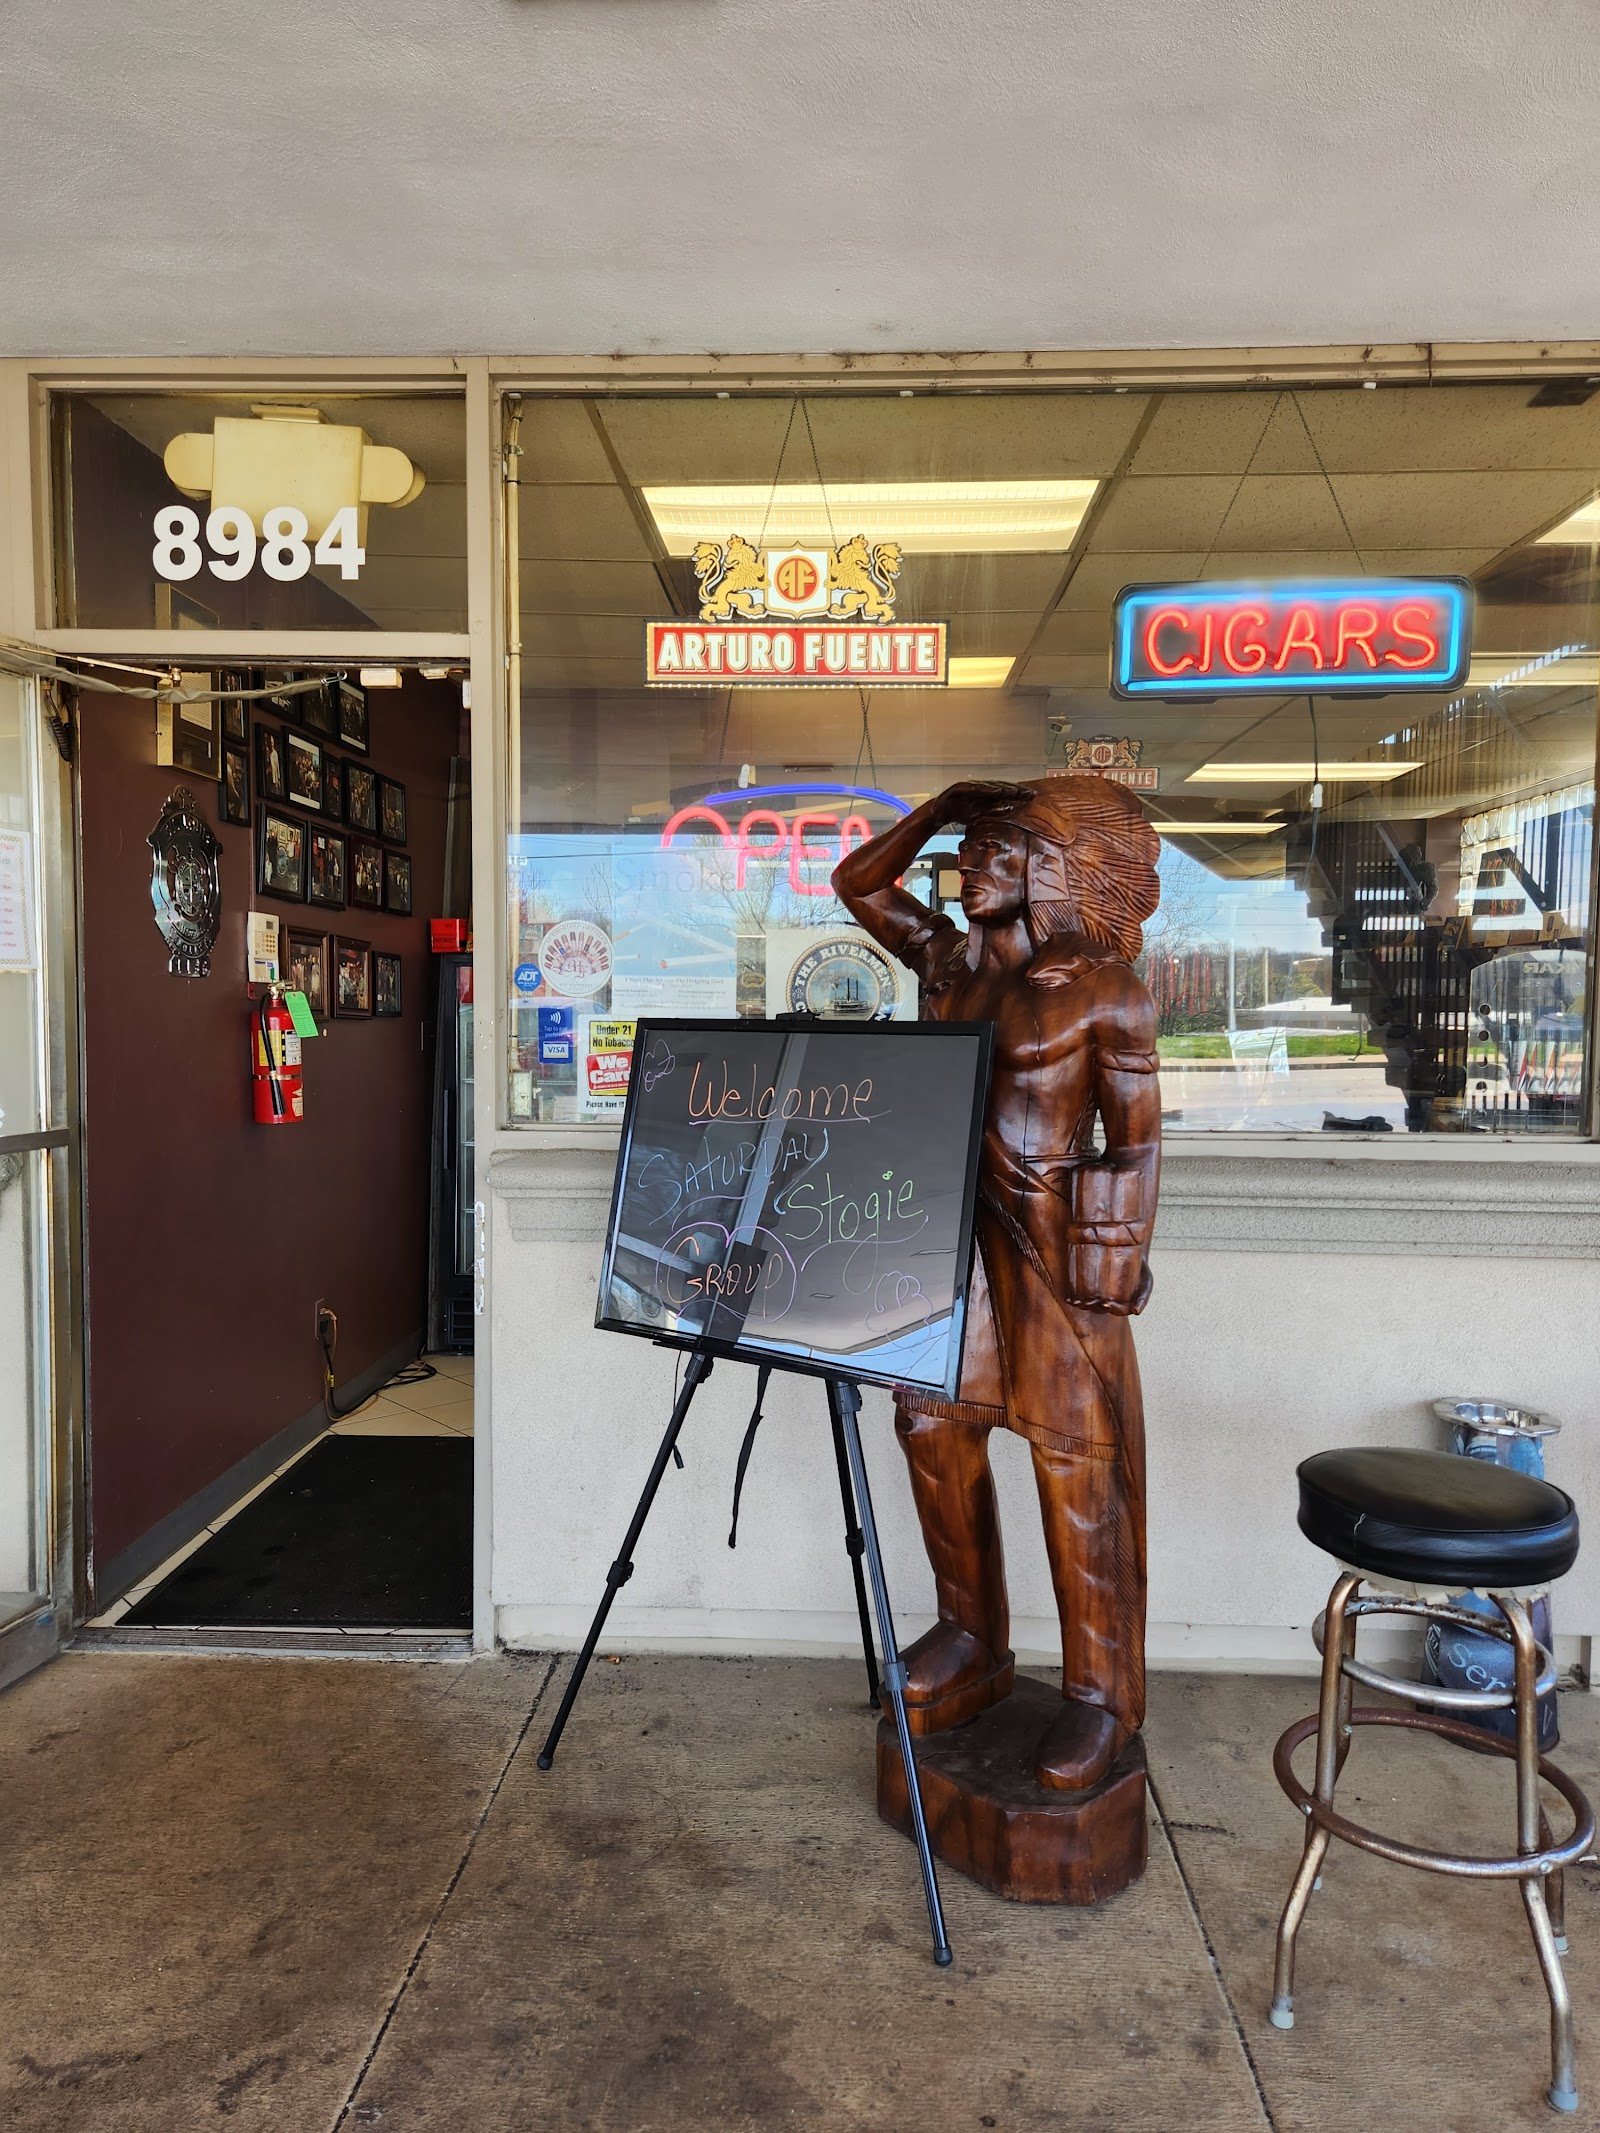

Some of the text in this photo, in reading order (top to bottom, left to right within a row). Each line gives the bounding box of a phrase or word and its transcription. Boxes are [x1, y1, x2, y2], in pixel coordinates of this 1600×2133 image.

[153, 505, 366, 581] 8984
[778, 558, 815, 598] AF
[657, 632, 937, 672] ARTURO FUENTE
[1147, 607, 1436, 675] CIGARS
[518, 971, 538, 981] ADT
[795, 944, 892, 988] THE RIVERMEN
[592, 1037, 602, 1047] No
[597, 1025, 631, 1035] Under 21
[596, 1055, 629, 1069] We
[688, 1061, 874, 1121] Welcome
[638, 1128, 829, 1226] SATURDAY
[785, 1170, 923, 1293] Stogie
[667, 1236, 783, 1318] GROUP
